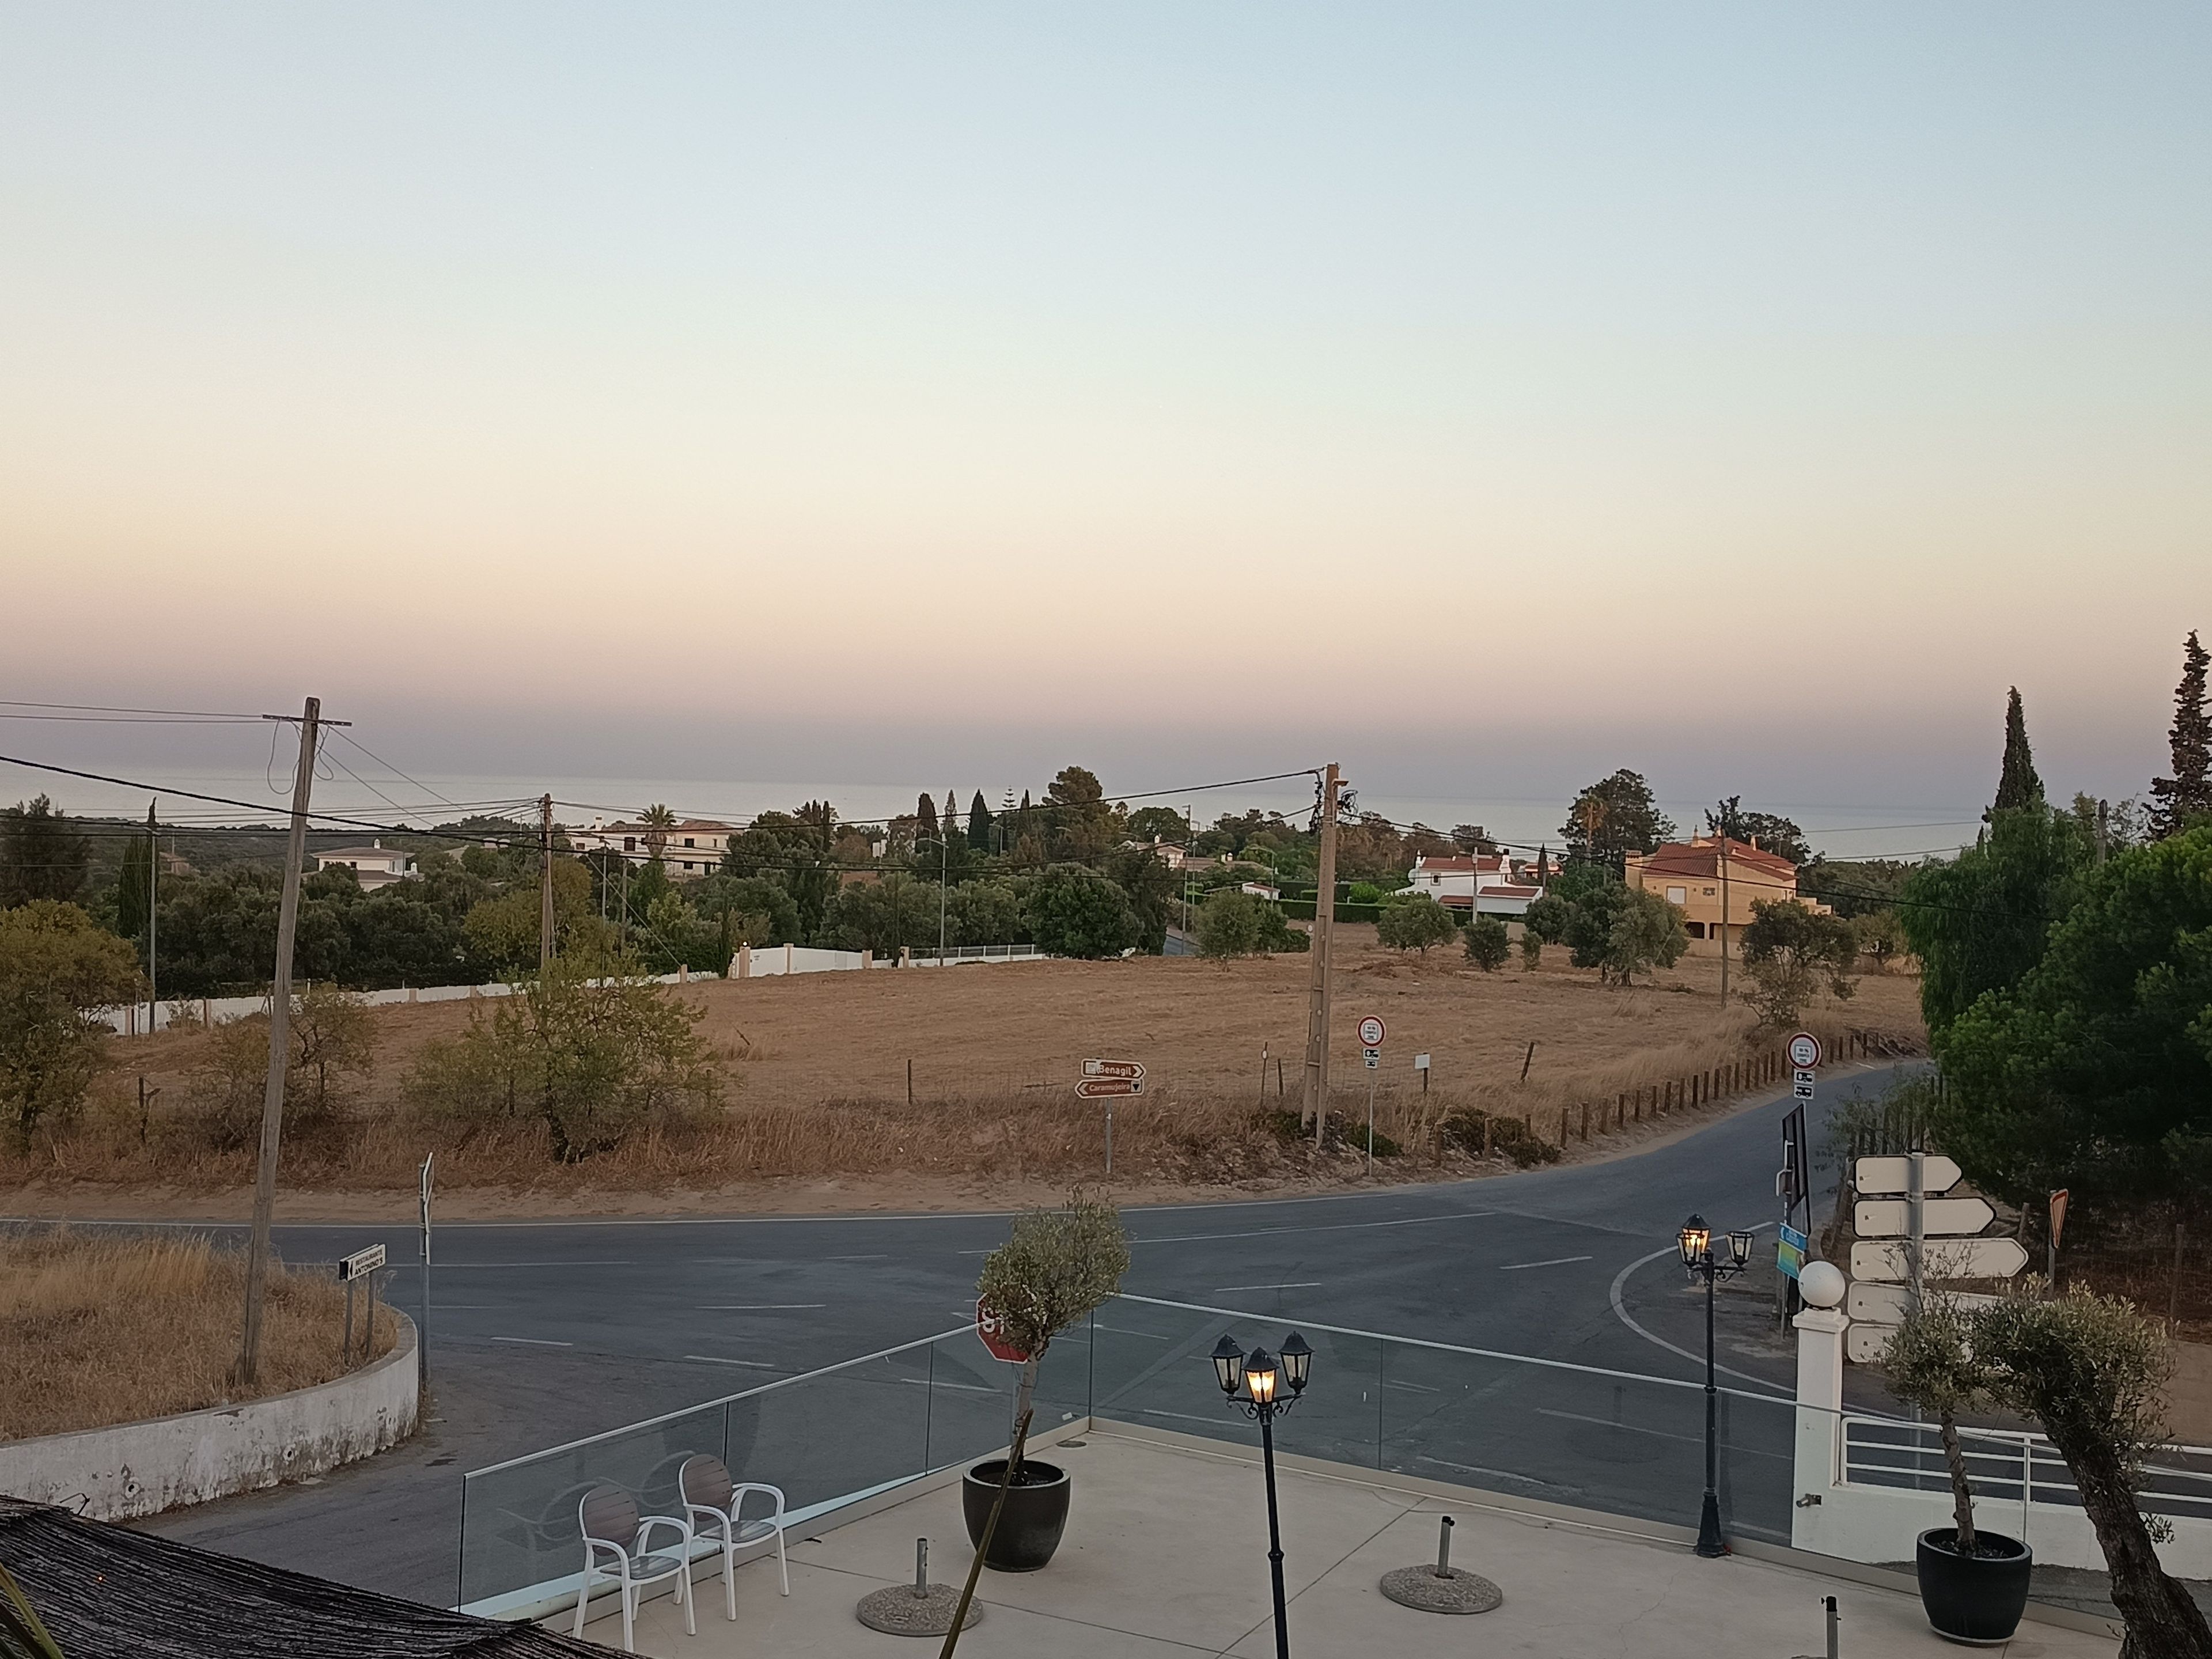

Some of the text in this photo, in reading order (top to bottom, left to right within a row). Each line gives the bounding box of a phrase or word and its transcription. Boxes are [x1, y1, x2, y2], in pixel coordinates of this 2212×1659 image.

[1099, 1065, 1132, 1076] Benagil
[1089, 1083, 1130, 1092] Caramujeira
[355, 1249, 382, 1266] RESTAURANTE
